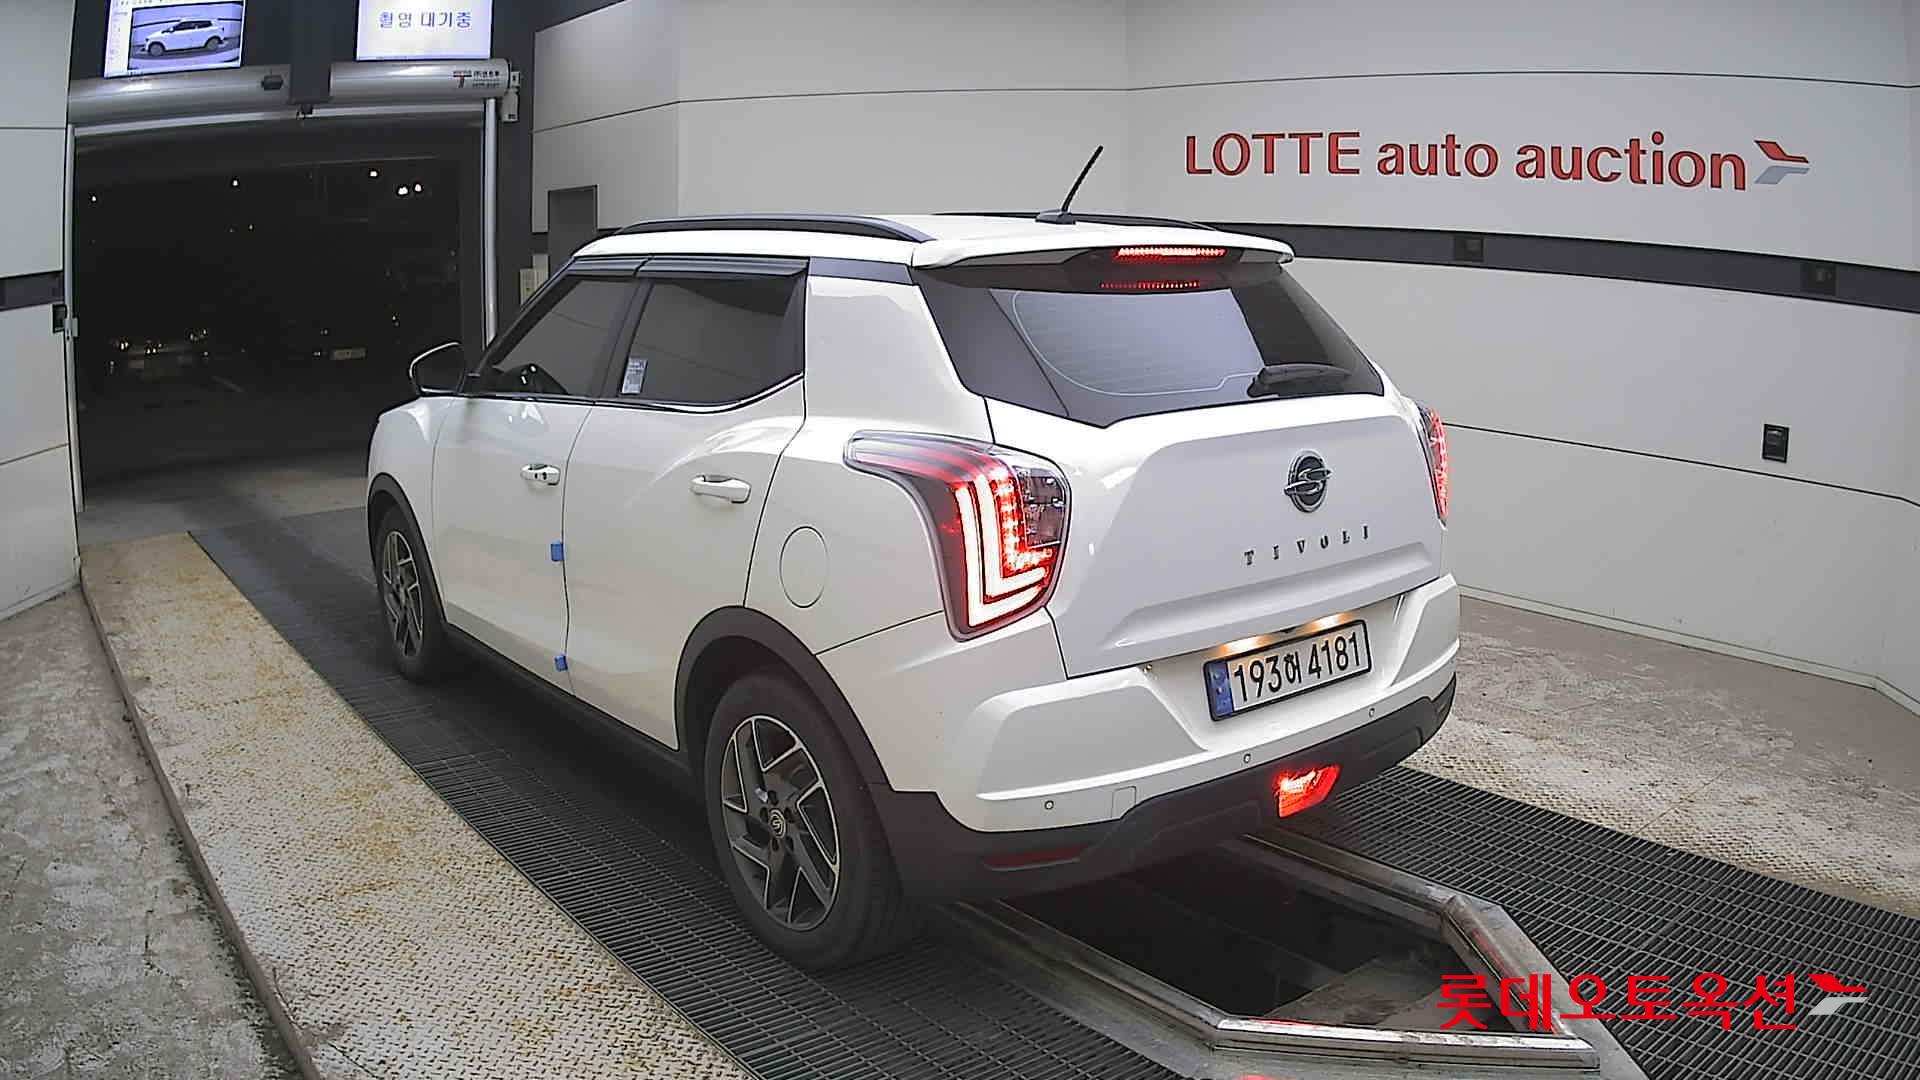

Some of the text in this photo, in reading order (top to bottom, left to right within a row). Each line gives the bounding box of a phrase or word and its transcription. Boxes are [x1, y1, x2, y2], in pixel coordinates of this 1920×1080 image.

[421, 11, 471, 28] 대기중
[1185, 131, 1746, 191] LOTTE auto auction
[1243, 524, 1370, 566] TIVOLI
[1308, 631, 1360, 679] 4181
